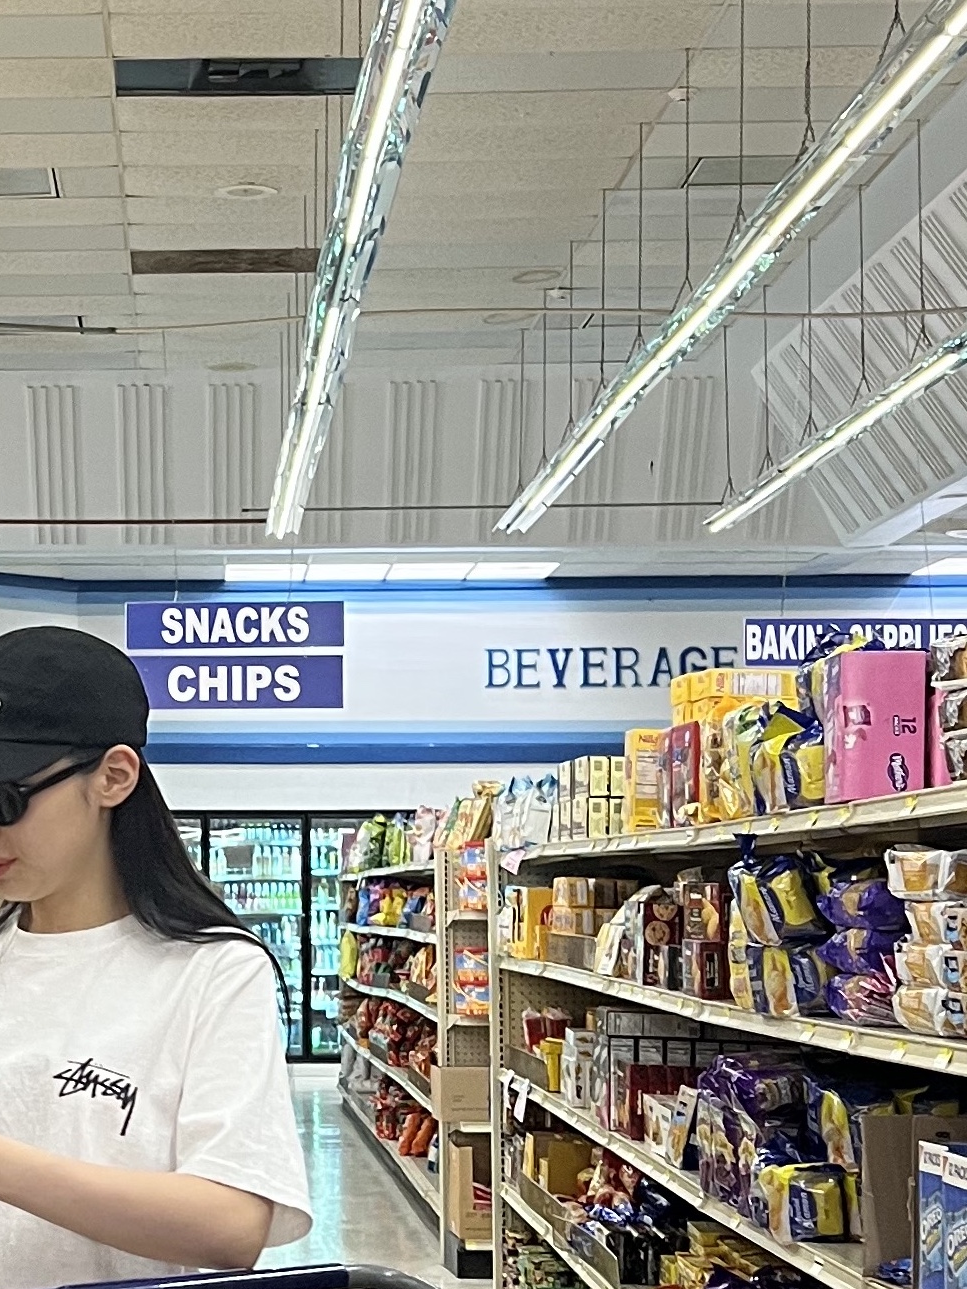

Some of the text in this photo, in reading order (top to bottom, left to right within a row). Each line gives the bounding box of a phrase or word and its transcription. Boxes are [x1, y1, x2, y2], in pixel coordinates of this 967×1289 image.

[161, 606, 310, 644] SNACKS
[746, 624, 840, 660] BAKIN
[167, 664, 301, 702] CHIPS
[901, 716, 917, 735] 12
